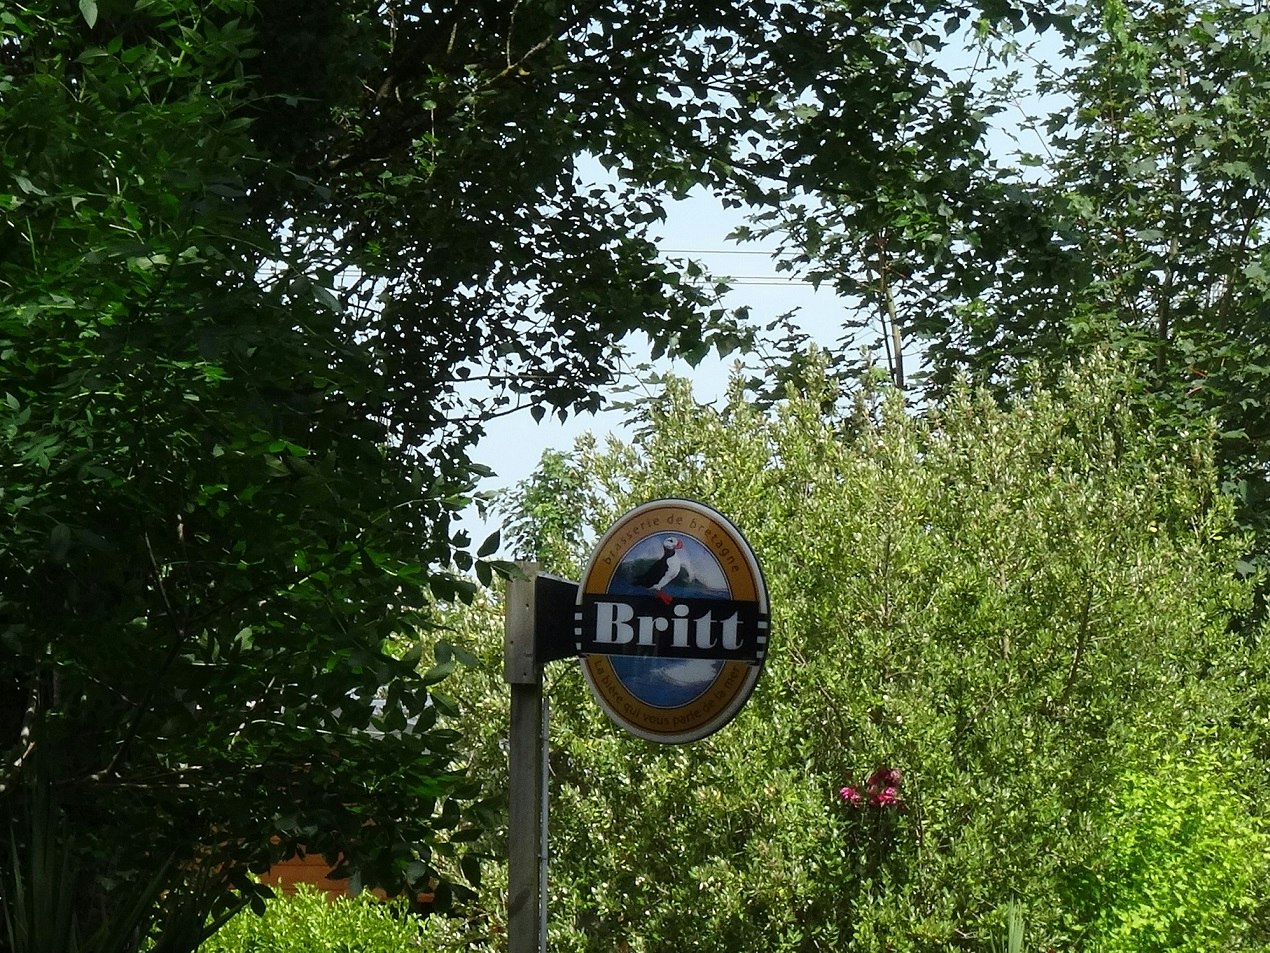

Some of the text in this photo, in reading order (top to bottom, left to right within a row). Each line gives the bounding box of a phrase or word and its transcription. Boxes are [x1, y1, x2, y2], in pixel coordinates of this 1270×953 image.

[603, 514, 739, 573] brasserie de bretagne
[592, 601, 744, 650] Britt
[624, 703, 642, 718] qui
[643, 712, 671, 726] vous
[672, 710, 701, 727] parle
[702, 698, 714, 713] de
[724, 666, 741, 690] mer
